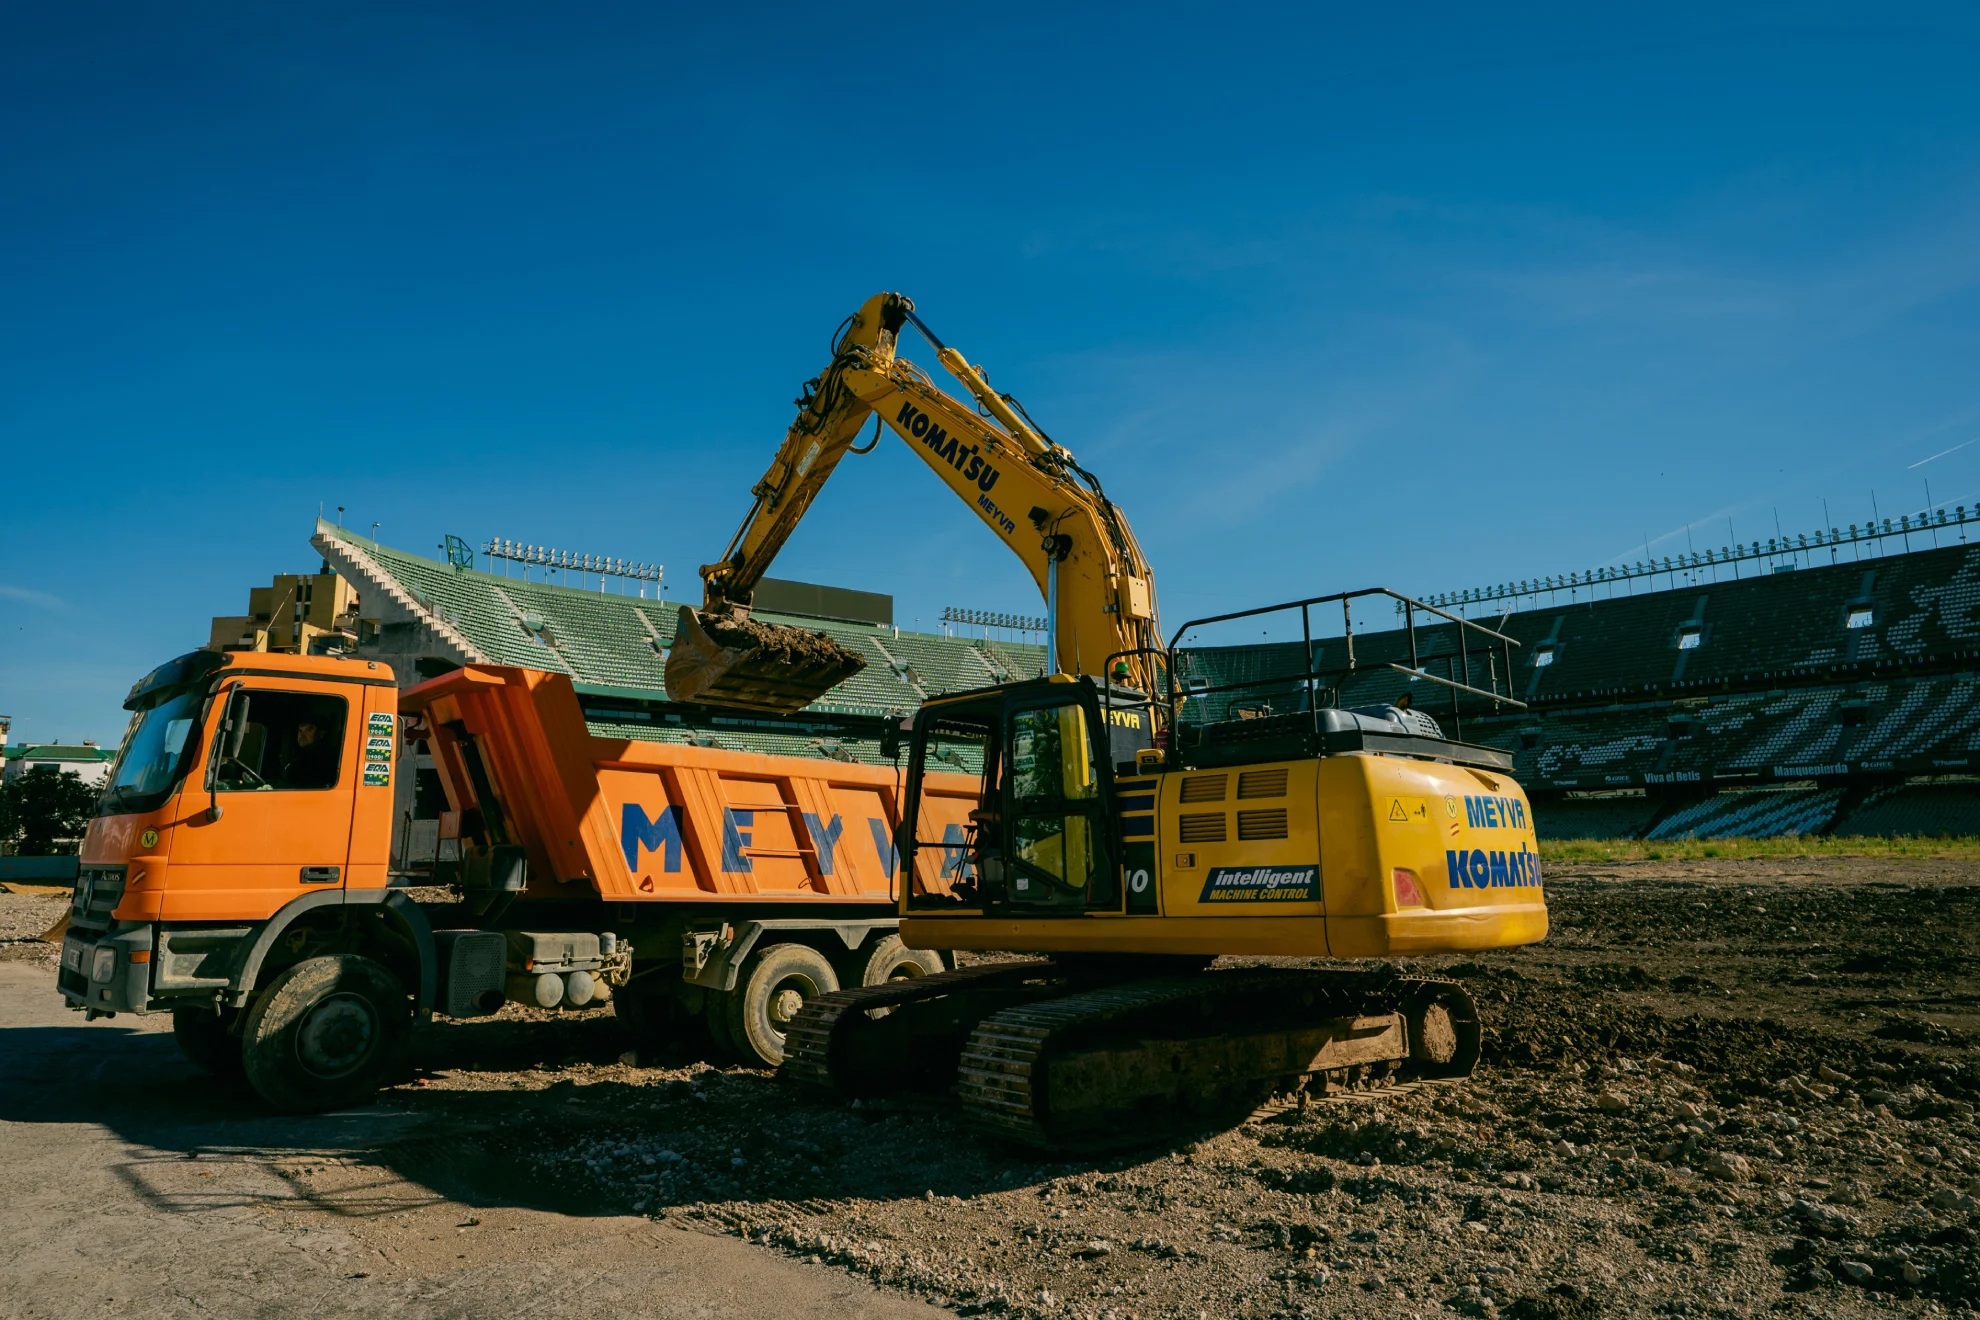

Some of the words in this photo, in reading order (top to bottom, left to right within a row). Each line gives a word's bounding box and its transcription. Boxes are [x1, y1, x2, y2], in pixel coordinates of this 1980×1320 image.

[896, 401, 1000, 492] KOMATSU
[1643, 683, 1658, 691] de
[1671, 676, 1729, 688] abuelos
[1831, 663, 1858, 672] una
[1876, 654, 1935, 668] pasión
[843, 707, 883, 715] recorre
[370, 714, 393, 722] EQA
[368, 739, 391, 747] EQA
[366, 764, 388, 772] EQA
[1773, 762, 1848, 777] Manquepierda
[1644, 773, 1664, 783] Viva
[1666, 772, 1674, 782] el
[1676, 770, 1700, 782] Betis
[1446, 842, 1542, 889] KOMATSU
[1215, 869, 1314, 888] intelligent
[1209, 888, 1257, 900] MACHINE
[1259, 887, 1309, 900] CONTROL
